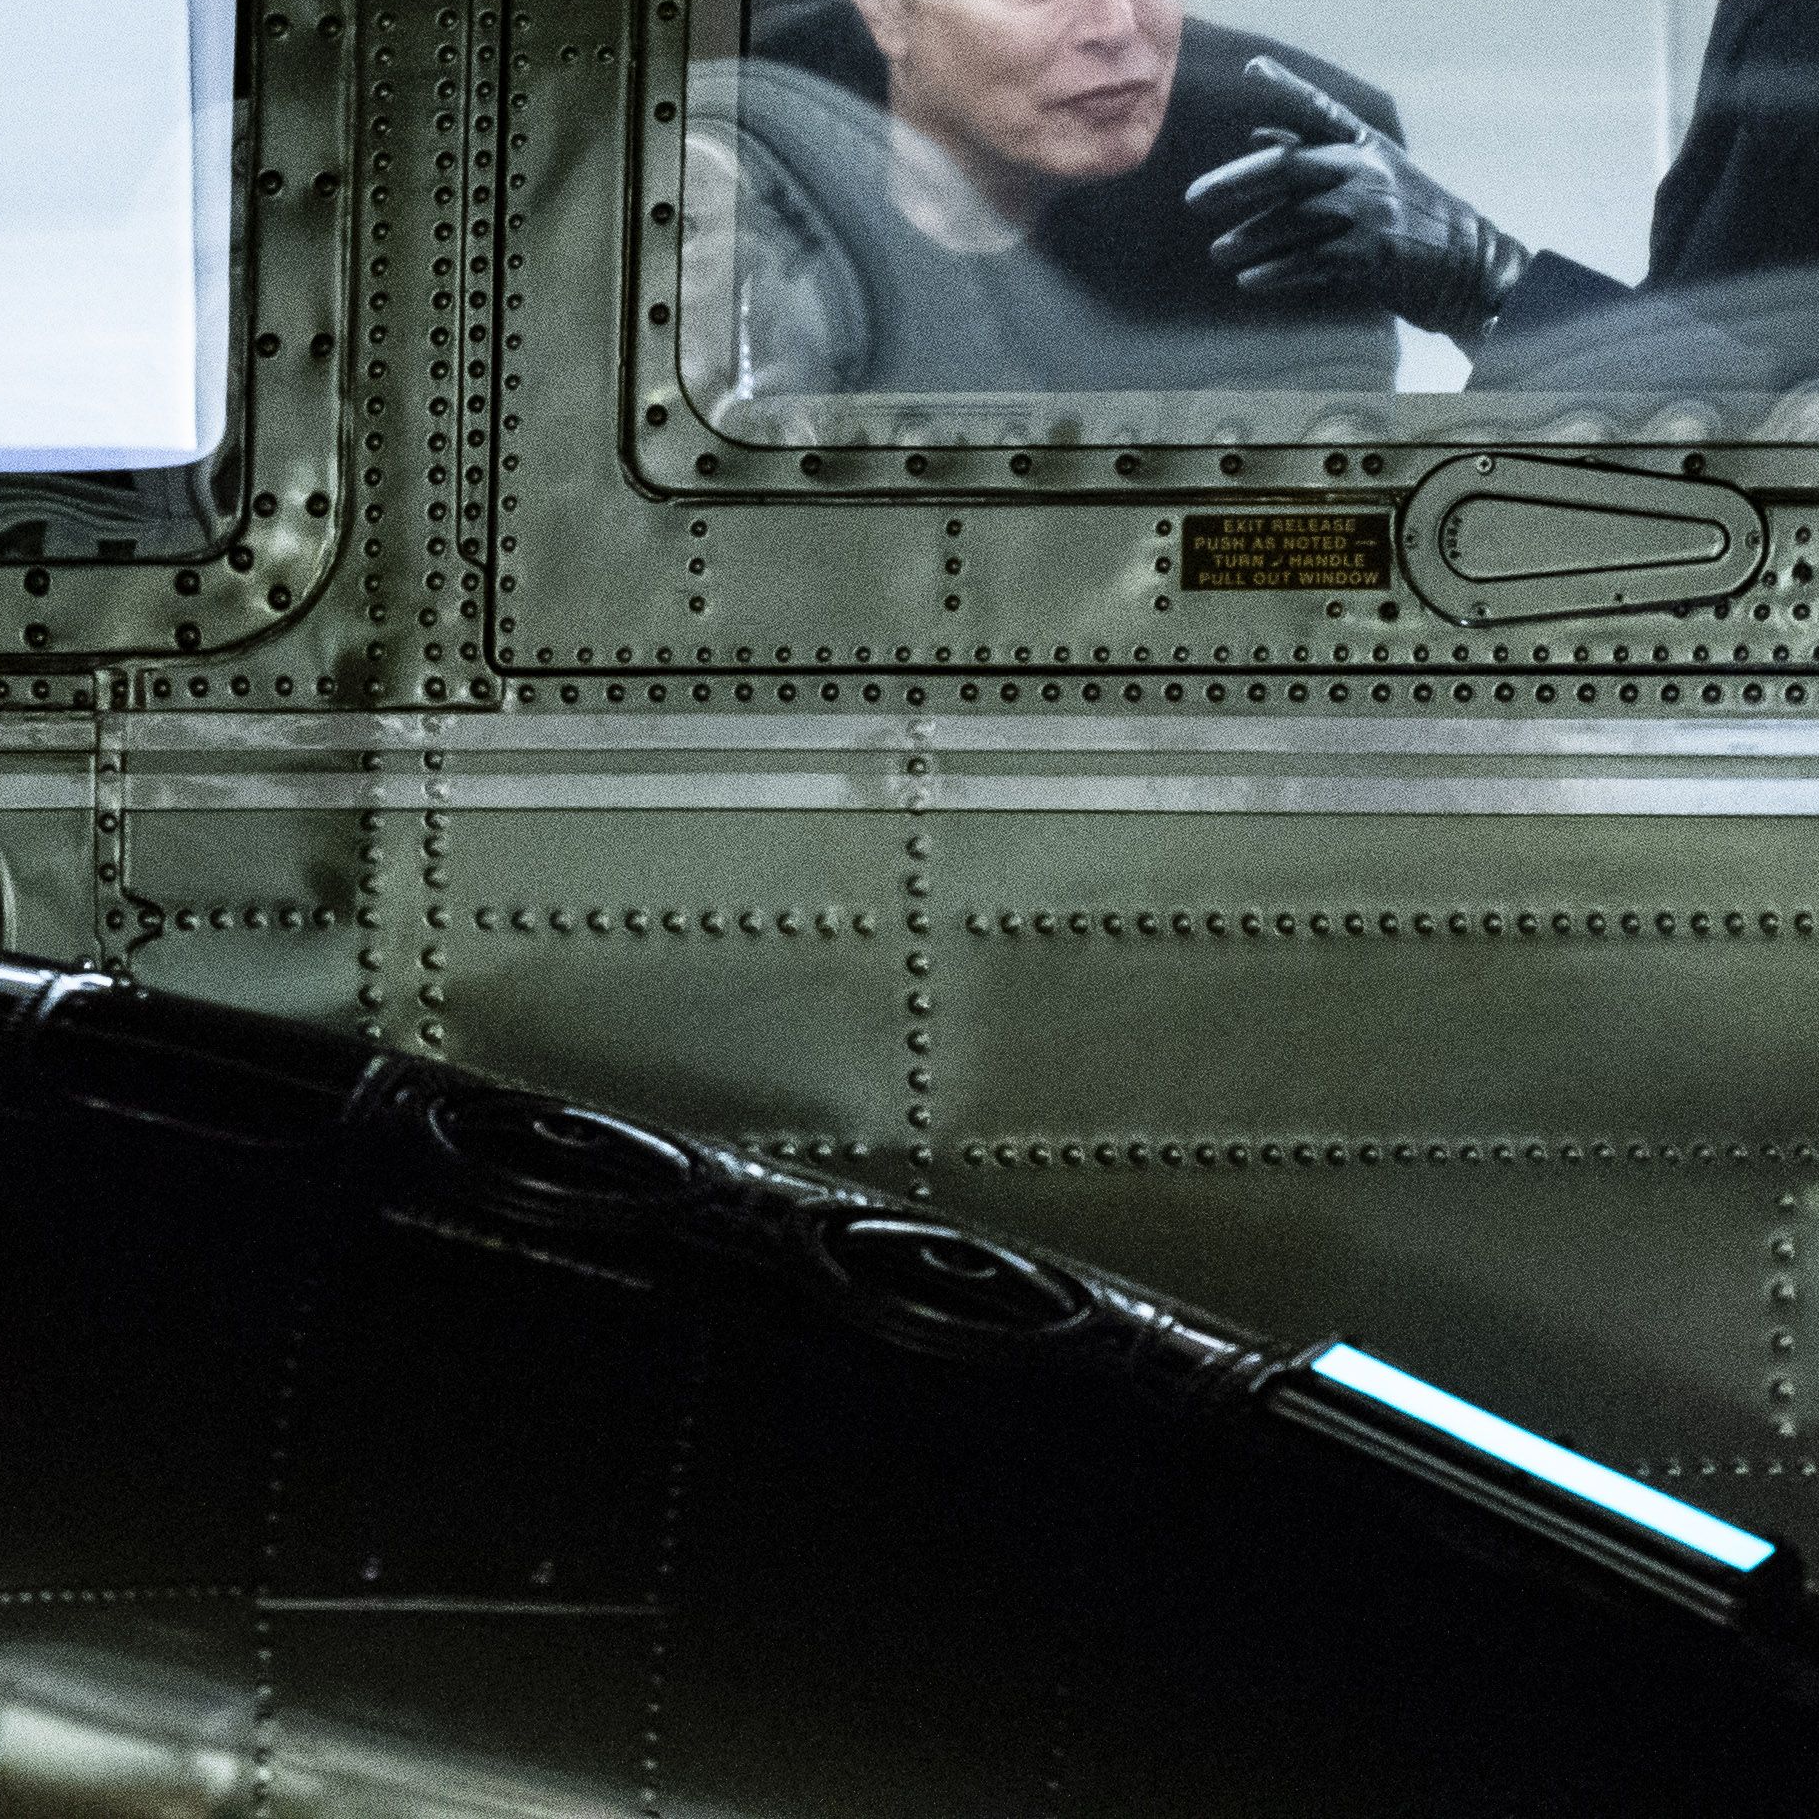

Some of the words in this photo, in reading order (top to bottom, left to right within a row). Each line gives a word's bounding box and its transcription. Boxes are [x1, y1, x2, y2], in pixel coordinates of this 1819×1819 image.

[1223, 518, 1265, 533] EXIT
[1270, 518, 1356, 533] RELEASE
[1193, 536, 1245, 550] PUSH
[1252, 536, 1276, 550] AS
[1283, 536, 1347, 550] NOTED
[1214, 553, 1265, 568] TURN
[1288, 553, 1365, 568] HANDLE
[1198, 571, 1246, 585] PULL
[1253, 571, 1291, 585] OUT
[1299, 571, 1380, 585] WINDOW
